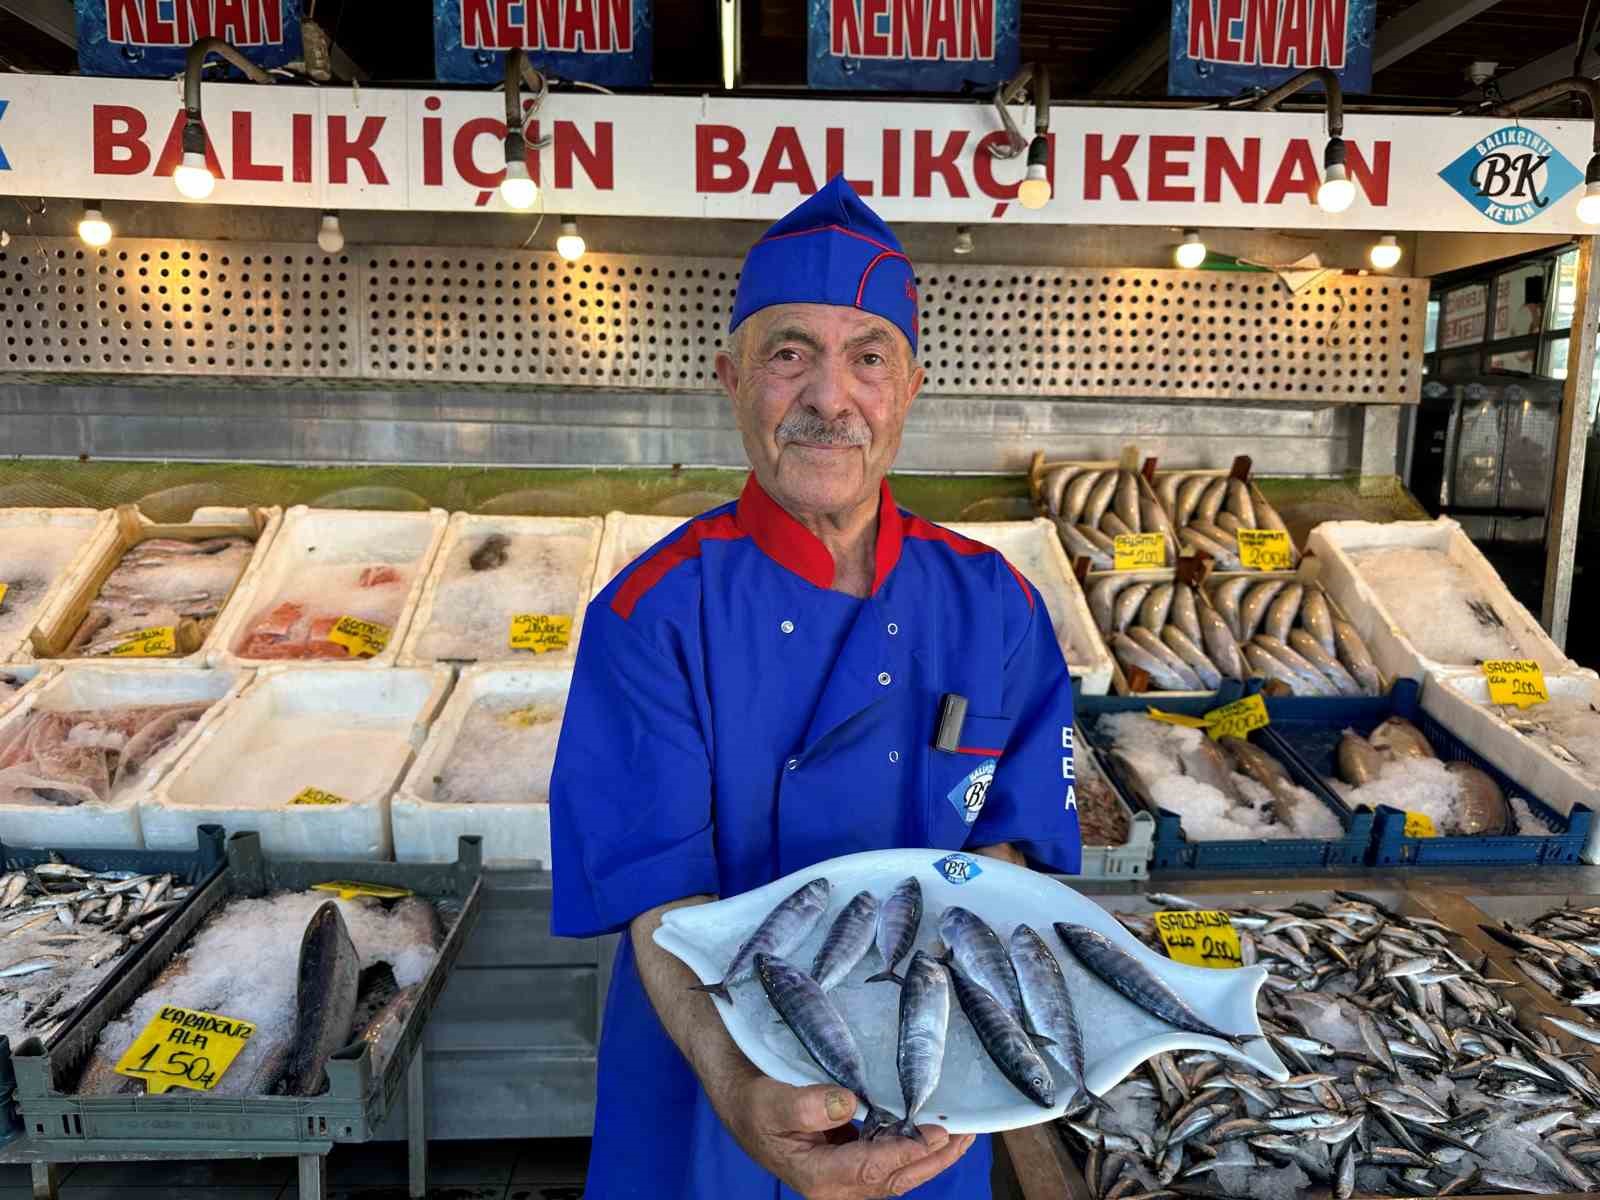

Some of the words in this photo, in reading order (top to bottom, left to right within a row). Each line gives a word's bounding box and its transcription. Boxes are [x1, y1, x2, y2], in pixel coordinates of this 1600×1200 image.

[829, 0, 995, 60] KENAN
[1187, 0, 1348, 69] KENAN
[93, 104, 389, 185] BALIK
[1083, 133, 1392, 207] KENAN
[1470, 152, 1551, 208] BK
[1484, 203, 1537, 222] KENAN
[167, 1027, 209, 1050] ALA
